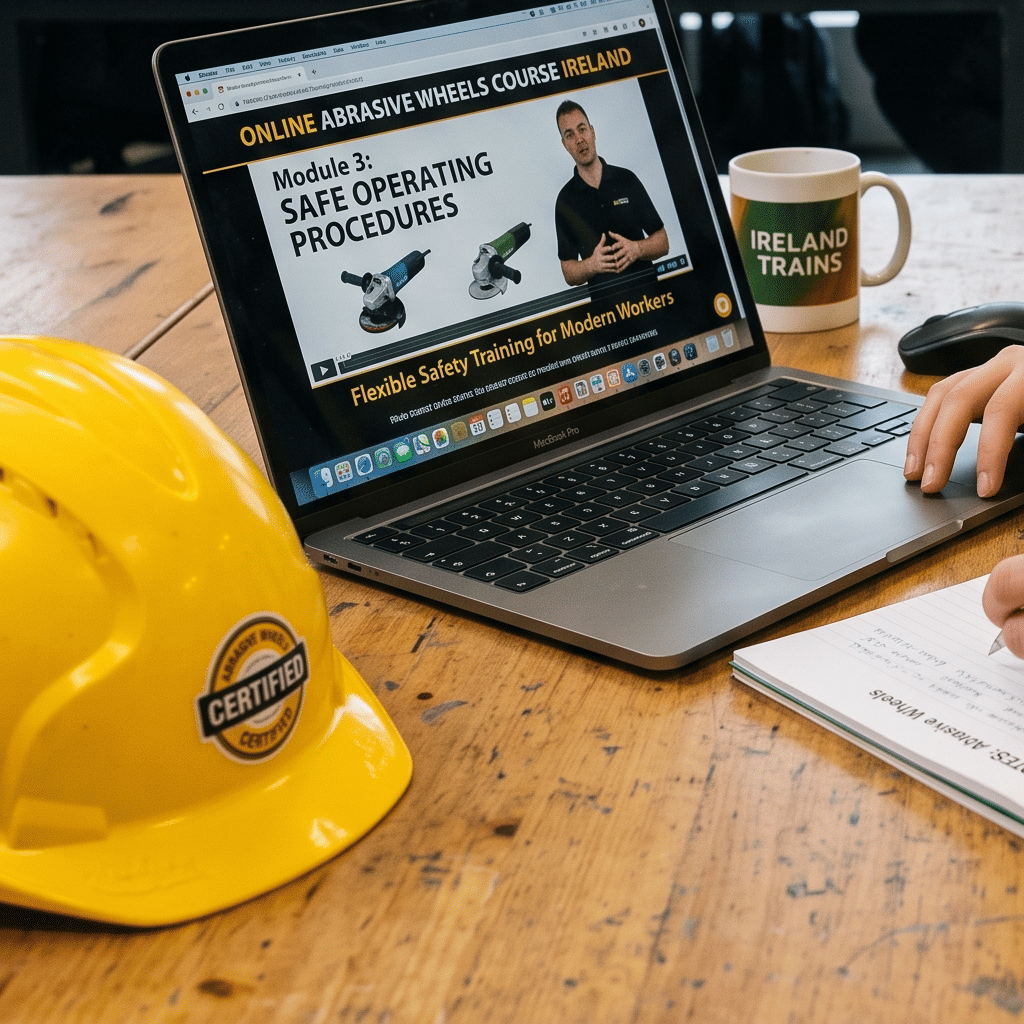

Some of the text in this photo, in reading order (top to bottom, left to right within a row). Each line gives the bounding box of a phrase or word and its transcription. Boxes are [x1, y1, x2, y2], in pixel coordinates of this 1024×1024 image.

[239, 47, 632, 147] ONLINE ABRASIVE WHEELS COURSE IRELAND
[272, 152, 373, 192] Module 3:
[280, 151, 494, 225] SAFE OPERATING
[289, 192, 459, 258] PROCEDURES
[750, 227, 849, 253] IRELAND
[757, 252, 842, 278] TRAINS
[350, 371, 418, 407] Flexible
[418, 355, 469, 385] Safety
[469, 337, 535, 370] Training
[535, 328, 557, 348] for
[559, 310, 617, 340] Modern
[615, 291, 675, 320] Workers
[566, 426, 580, 440] Pro
[207, 653, 305, 727] CERTIFIED
[867, 687, 927, 722] Wheels
